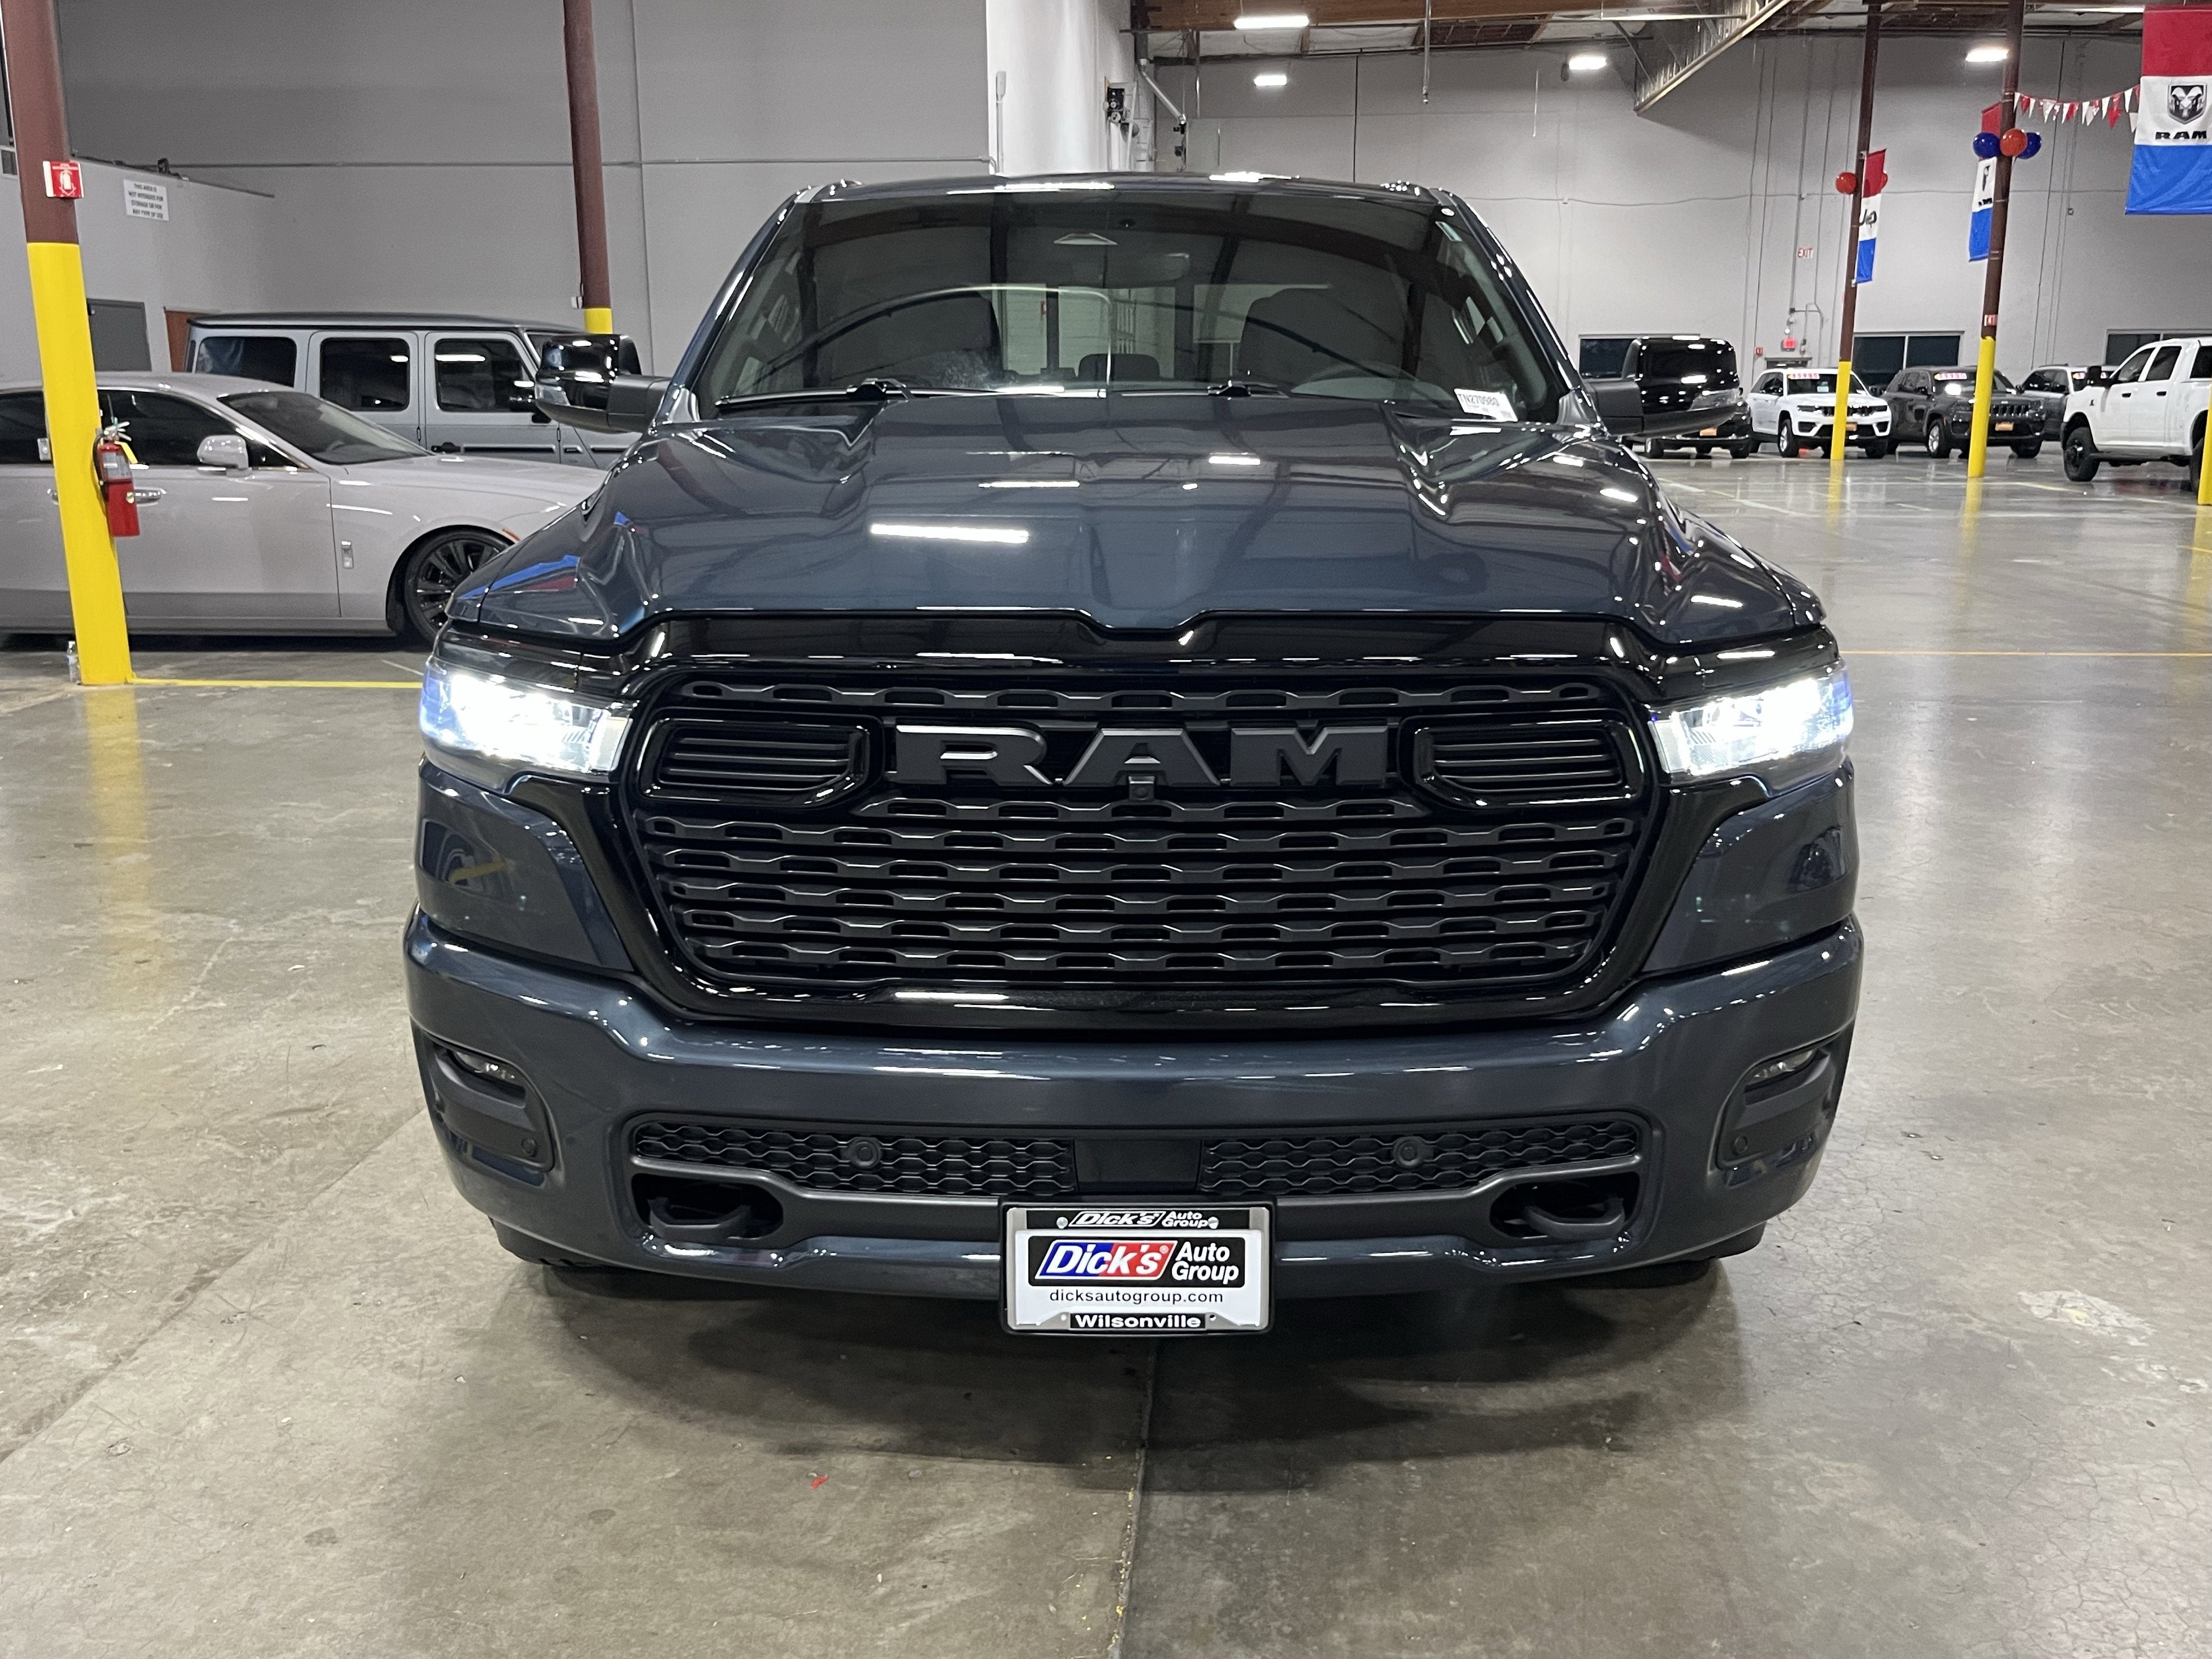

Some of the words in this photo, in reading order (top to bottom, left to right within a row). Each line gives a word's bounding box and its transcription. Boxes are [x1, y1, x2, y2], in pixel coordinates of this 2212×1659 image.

[2155, 130, 2207, 140] RAM
[1797, 248, 1814, 258] EXIT
[896, 725, 1388, 787] RAM
[1166, 1211, 1203, 1220] Auto
[1161, 1218, 1208, 1228] Group
[1176, 1241, 1230, 1261] Auto
[1171, 1260, 1239, 1285] Group
[1049, 1289, 1223, 1305] dicksautogroup.com
[1075, 1314, 1201, 1328] Wilsonville
